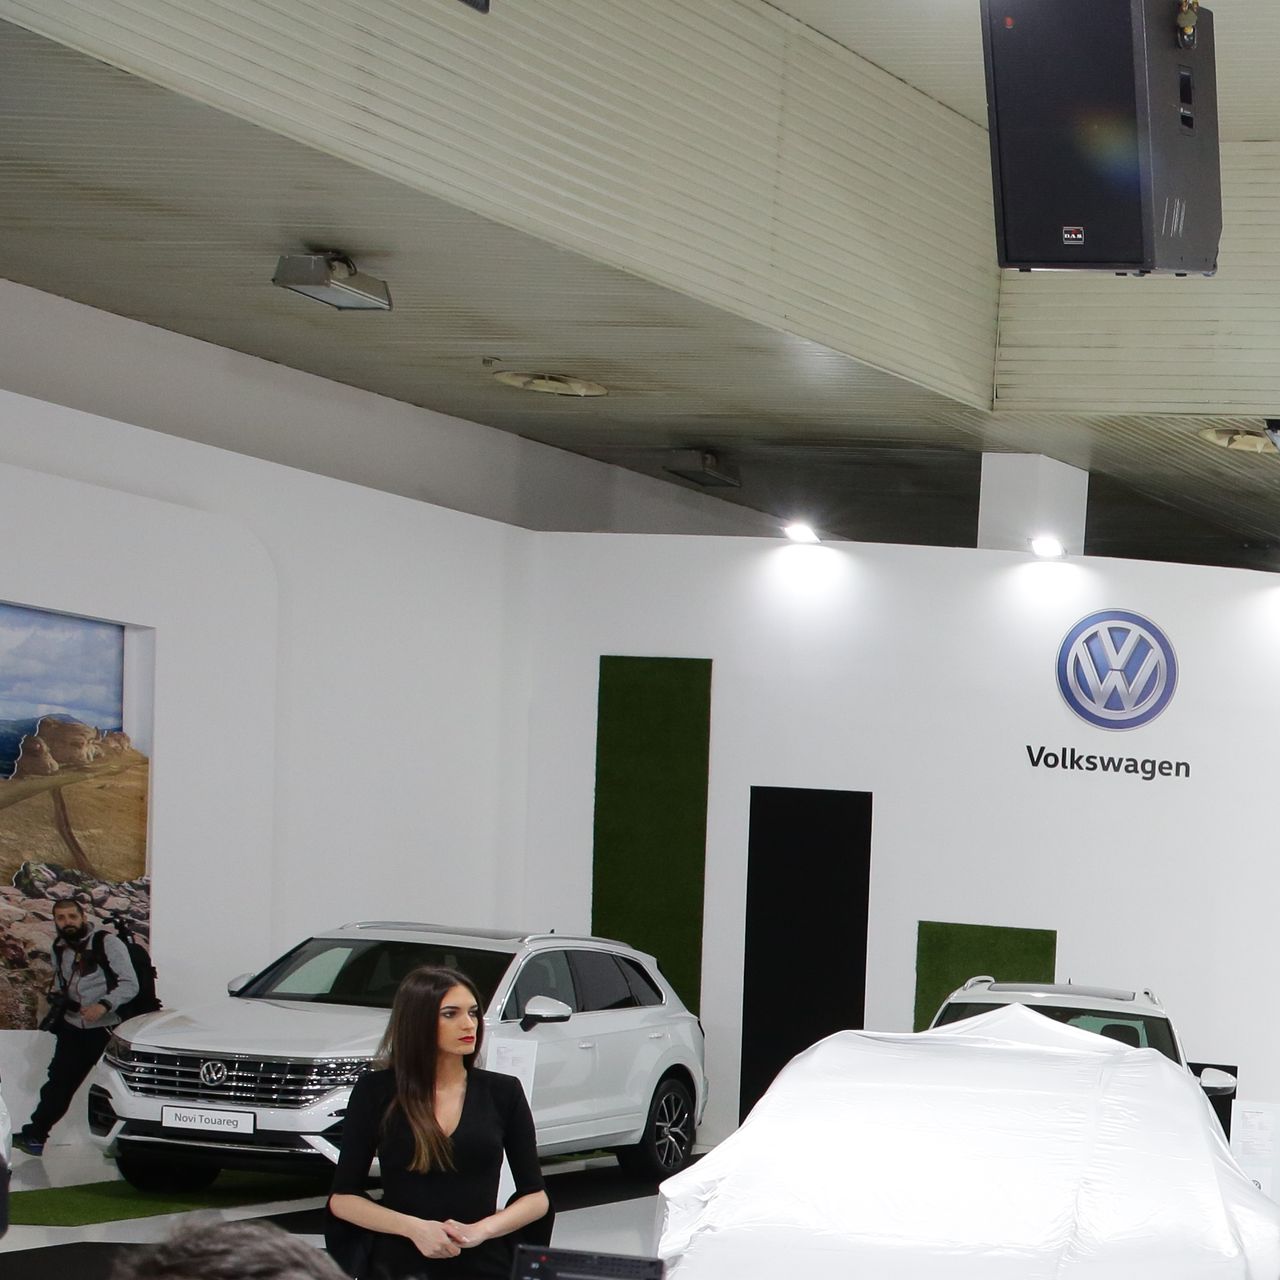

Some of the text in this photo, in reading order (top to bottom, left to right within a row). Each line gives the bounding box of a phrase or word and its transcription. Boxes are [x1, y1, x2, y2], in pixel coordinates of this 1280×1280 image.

[1065, 618, 1169, 722] VW
[1026, 745, 1190, 781] Volkswagen
[174, 1112, 239, 1129] Novi Touareg
